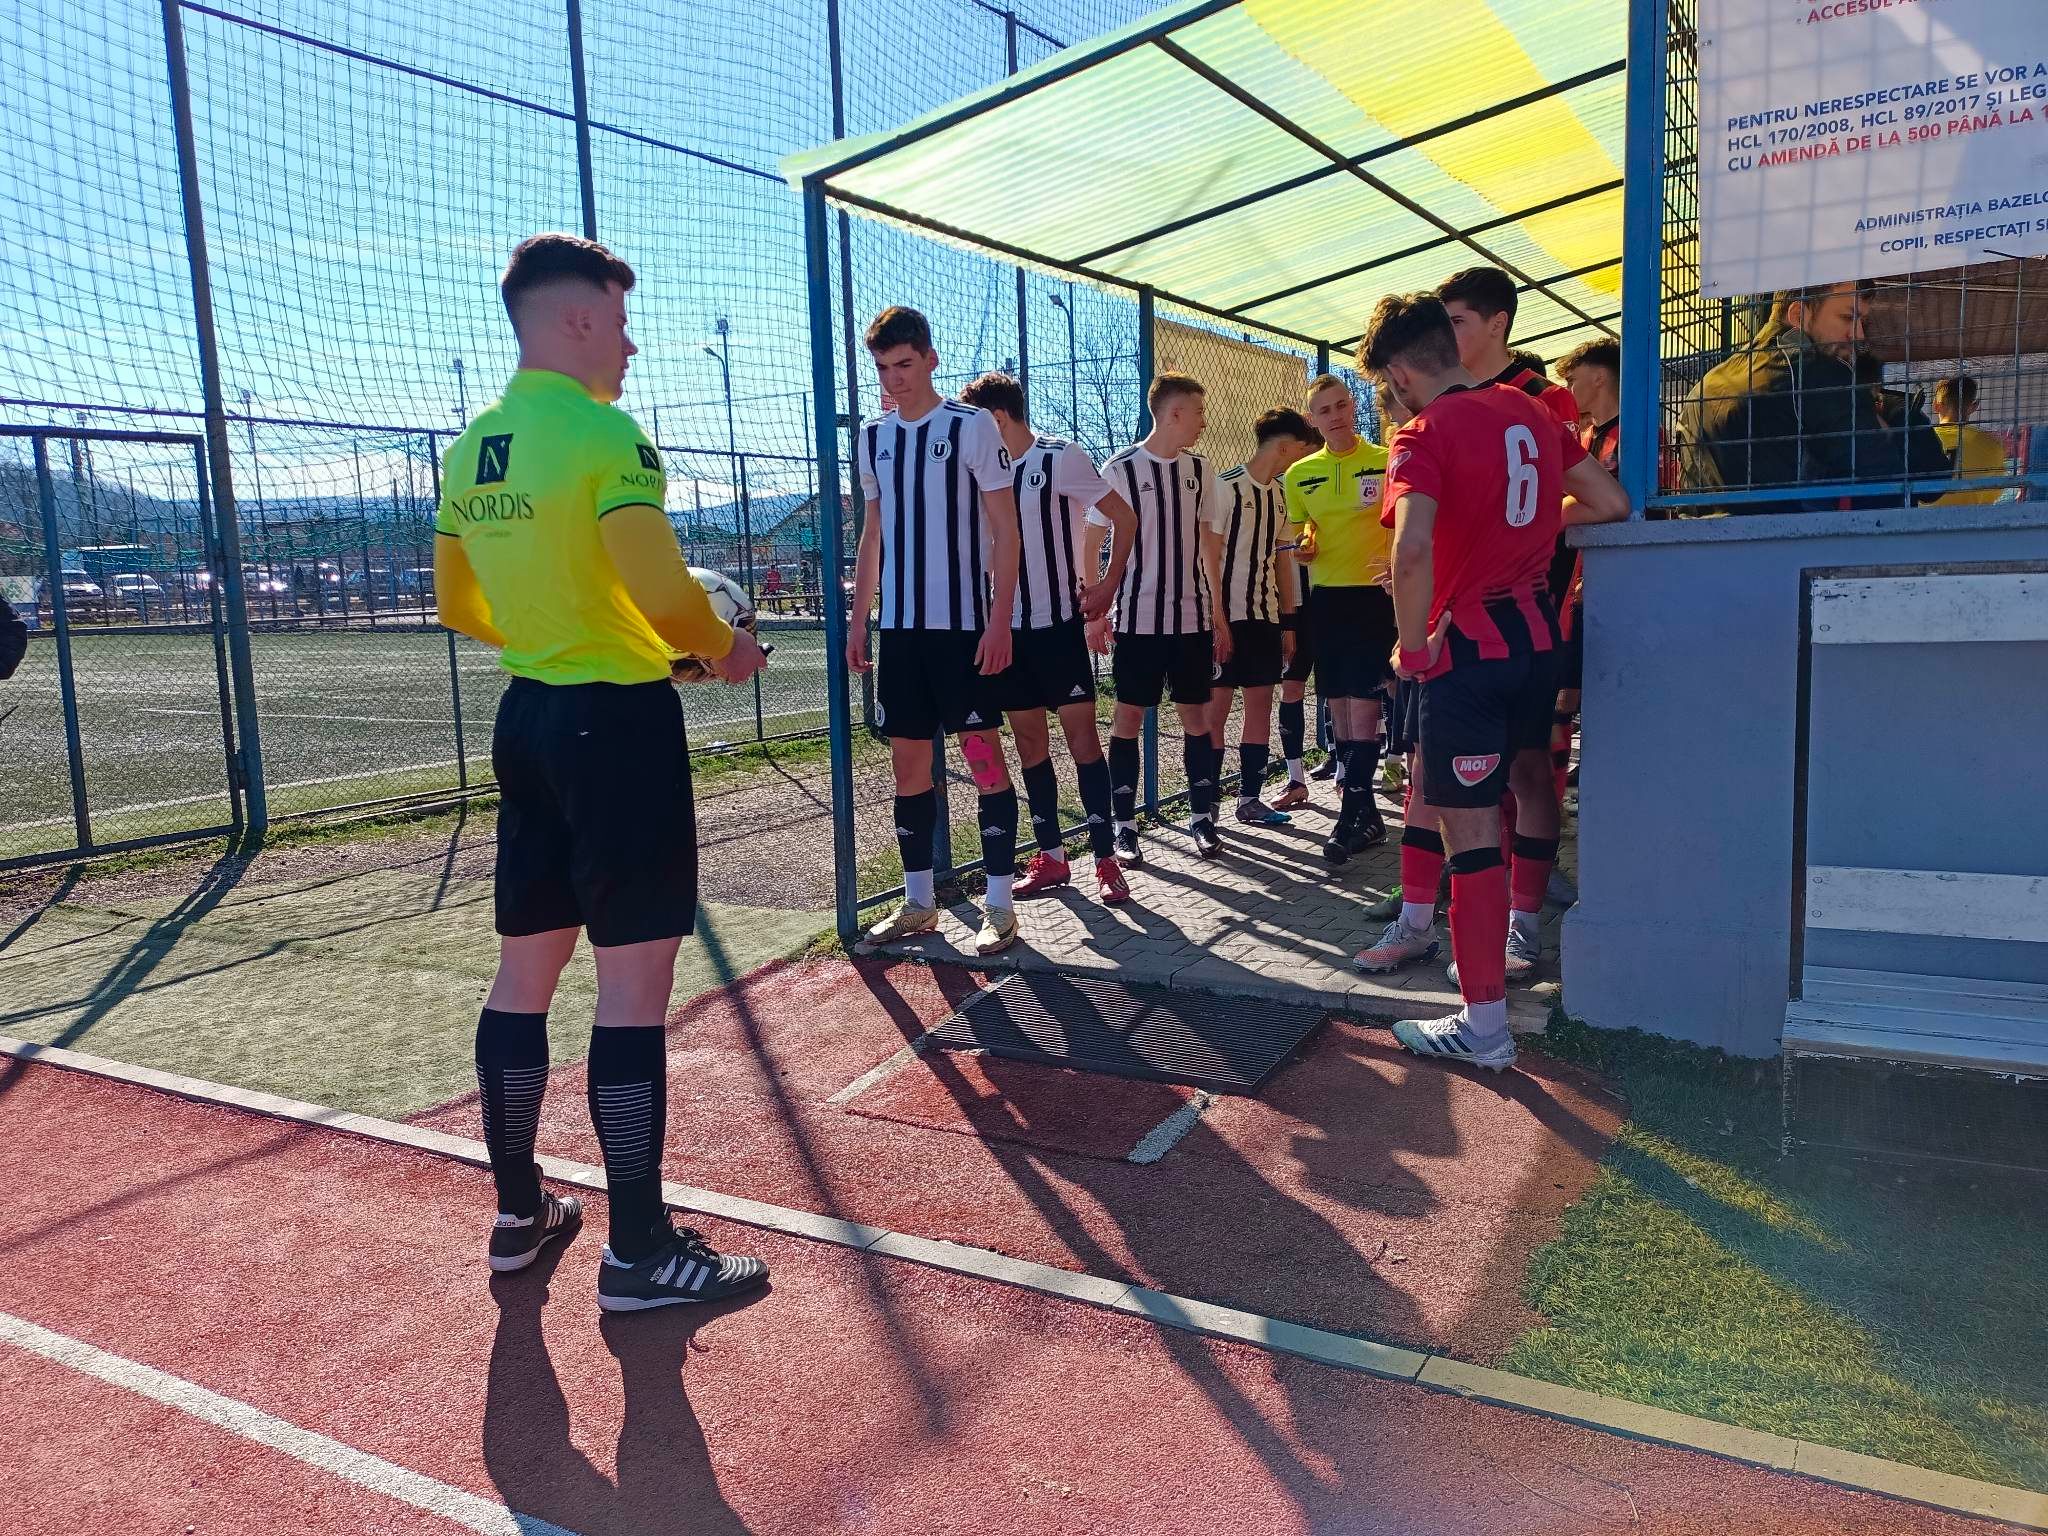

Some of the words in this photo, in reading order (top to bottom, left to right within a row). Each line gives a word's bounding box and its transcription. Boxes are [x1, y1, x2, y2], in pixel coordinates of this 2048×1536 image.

[1727, 106, 1798, 132] PENTRU
[1804, 79, 1949, 117] NERESPECTARE
[1955, 73, 1978, 91] SE
[1985, 65, 2028, 85] VOR
[1728, 134, 1762, 151] HCL
[1768, 118, 1854, 144] 170/2008,
[1861, 110, 1898, 128] HCL
[1904, 95, 1981, 121] 89/2017
[2010, 83, 2047, 102] LEG
[1728, 155, 1752, 171] CU
[1757, 137, 1841, 168] AMENDĂ
[1846, 135, 1872, 153] DE
[1878, 130, 1902, 147] LA
[1908, 123, 1942, 141] 500
[1947, 109, 2003, 134] PÂNĂ
[2009, 108, 2034, 124] LA
[1854, 201, 1983, 232] ADMINISTRAȚIA
[1880, 236, 1929, 253] COPII,
[1934, 221, 2030, 246] RESPECTAȚI
[1504, 424, 1539, 527] 6
[451, 492, 535, 528] NORDIS
[1460, 759, 1488, 772] MOL
